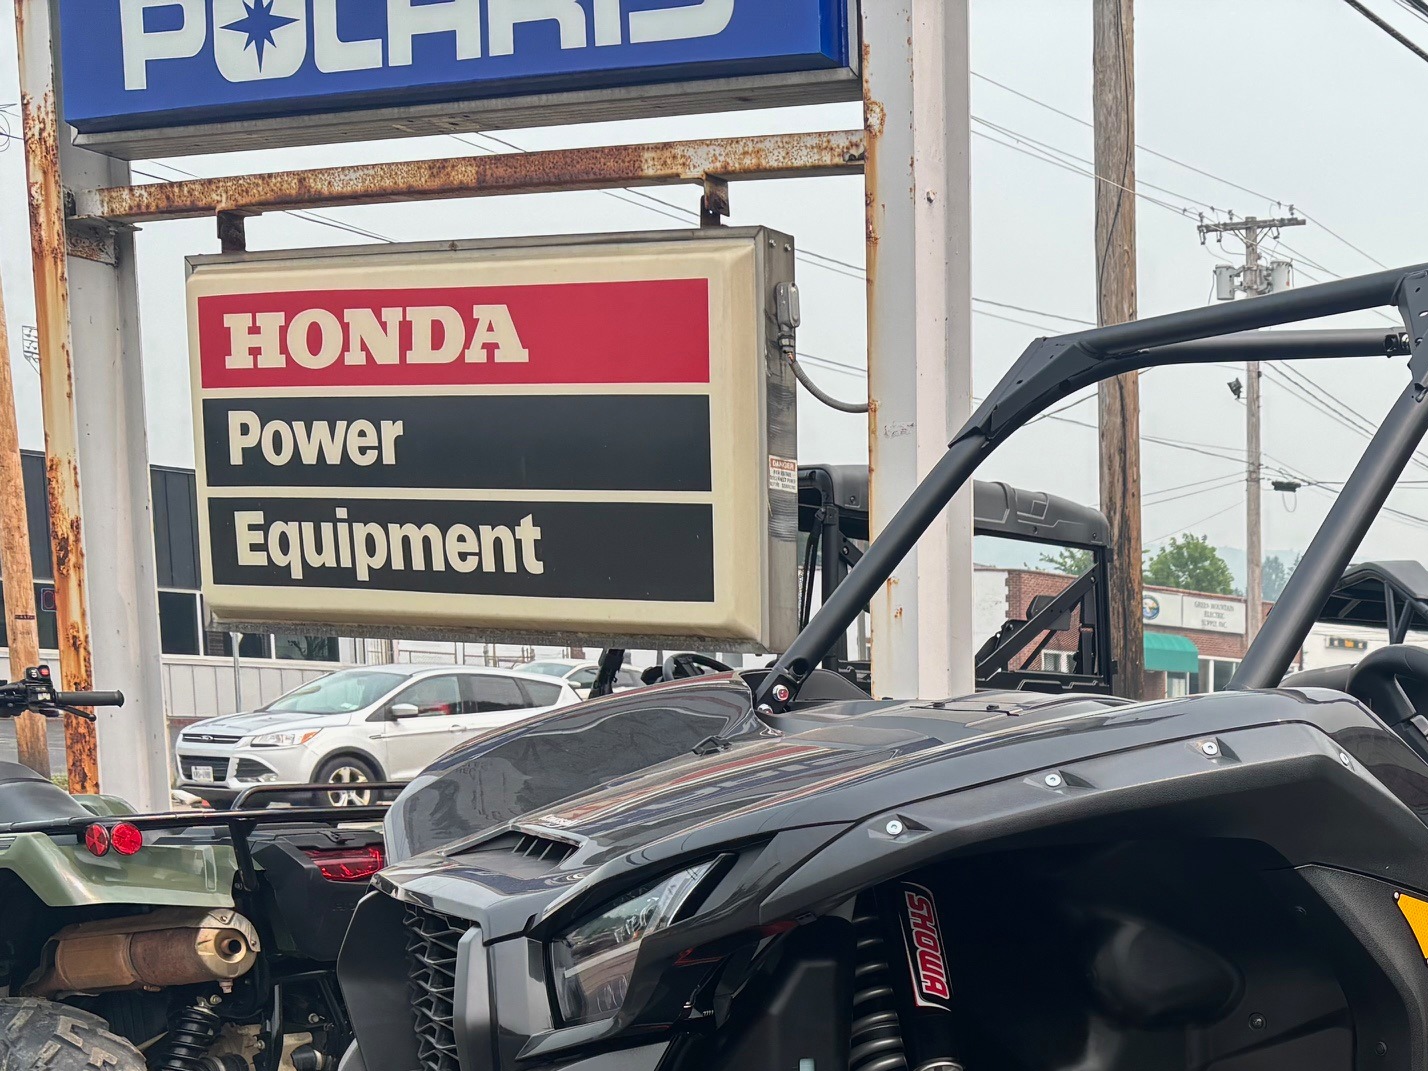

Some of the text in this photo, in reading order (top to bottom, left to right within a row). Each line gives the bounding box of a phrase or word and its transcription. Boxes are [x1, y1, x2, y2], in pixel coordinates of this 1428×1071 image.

[223, 304, 529, 369] HONDA
[228, 410, 404, 466] Power
[234, 507, 544, 581] Equipment
[905, 891, 950, 1000] SHOWA
